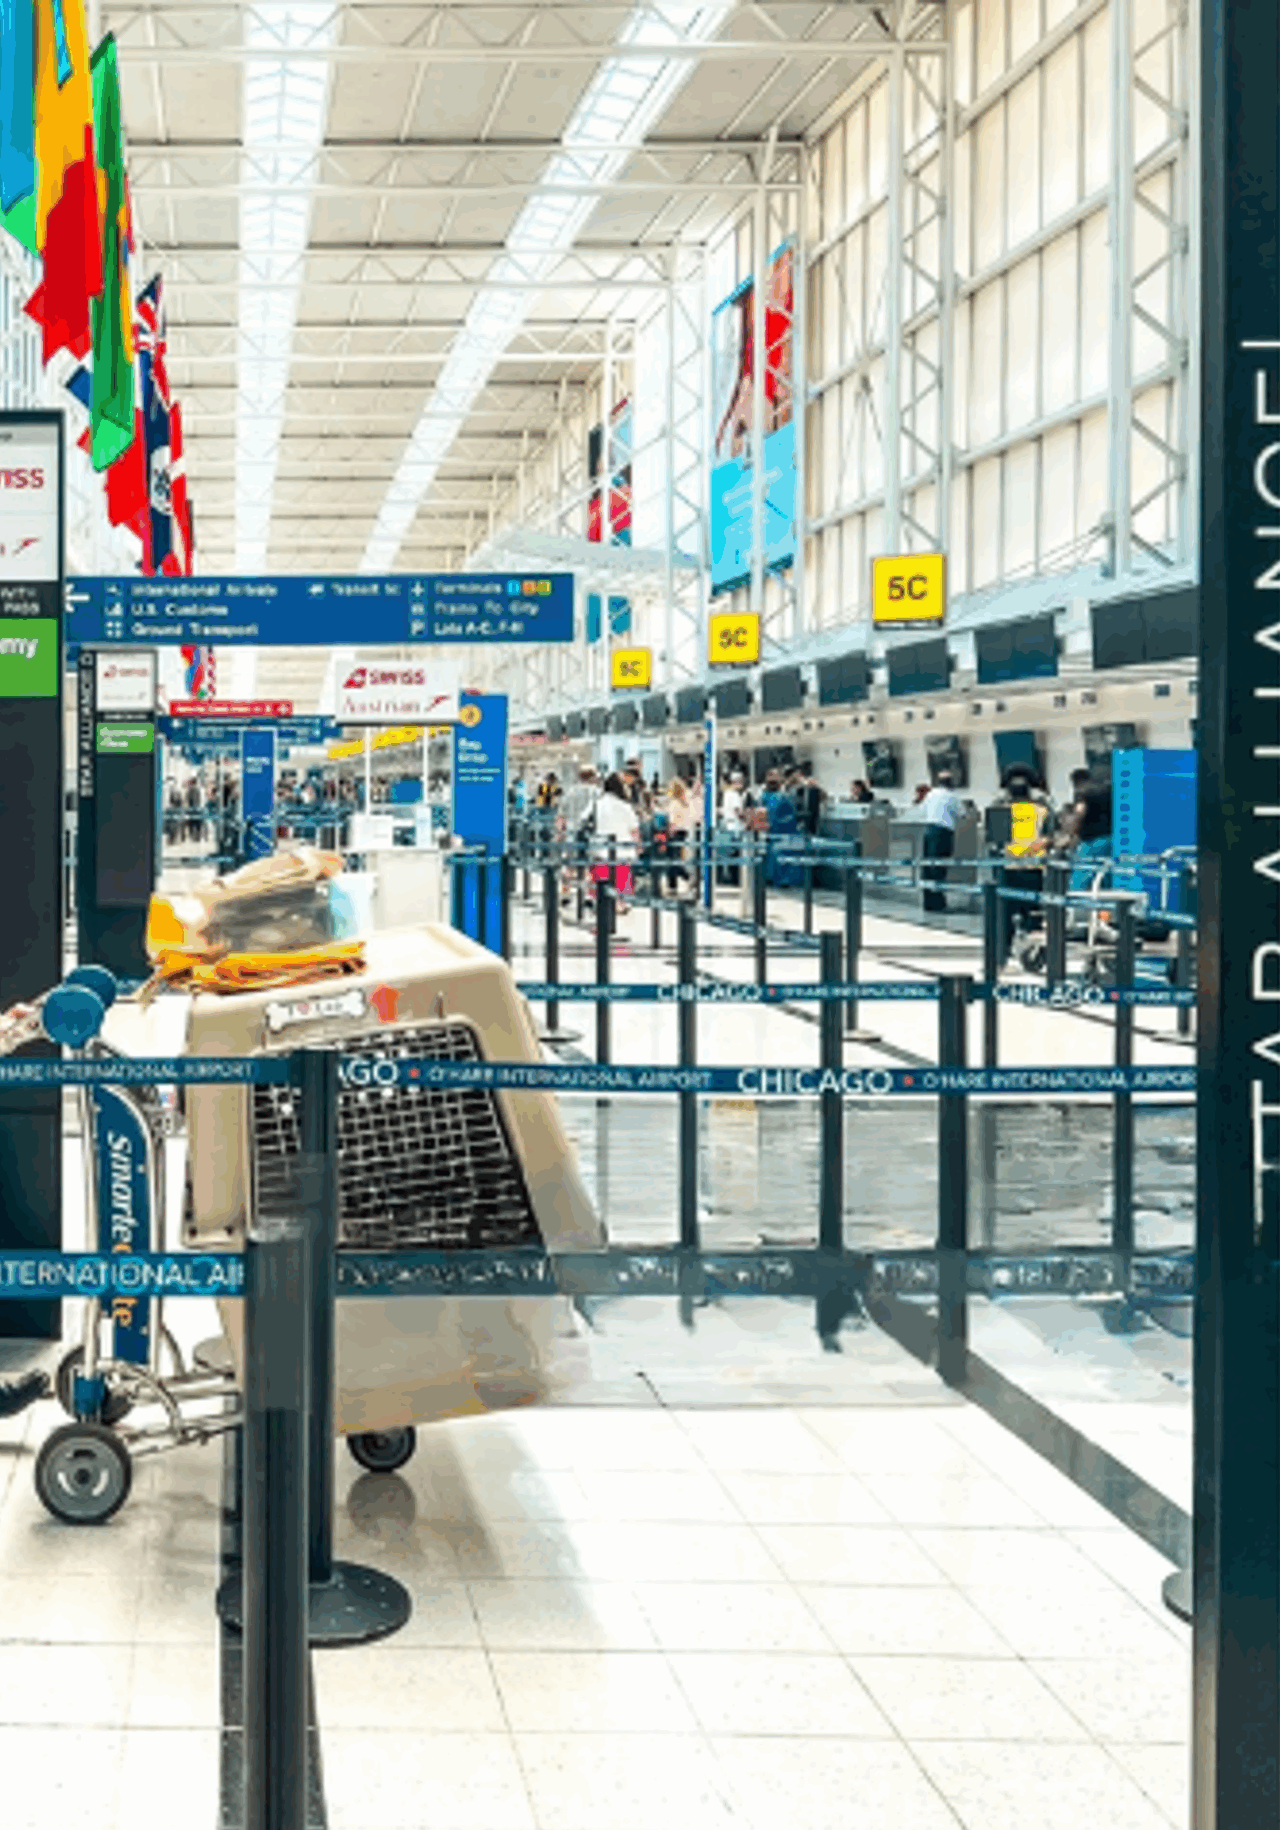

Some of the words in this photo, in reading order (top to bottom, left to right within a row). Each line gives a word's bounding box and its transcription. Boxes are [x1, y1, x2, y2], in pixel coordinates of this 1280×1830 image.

[888, 576, 928, 600] 5C
[656, 984, 763, 1002] CHICAGO
[992, 984, 1106, 1004] CHICAGO
[736, 1068, 894, 1094] CHICAGO
[1134, 1070, 1198, 1089] AIRPOR
